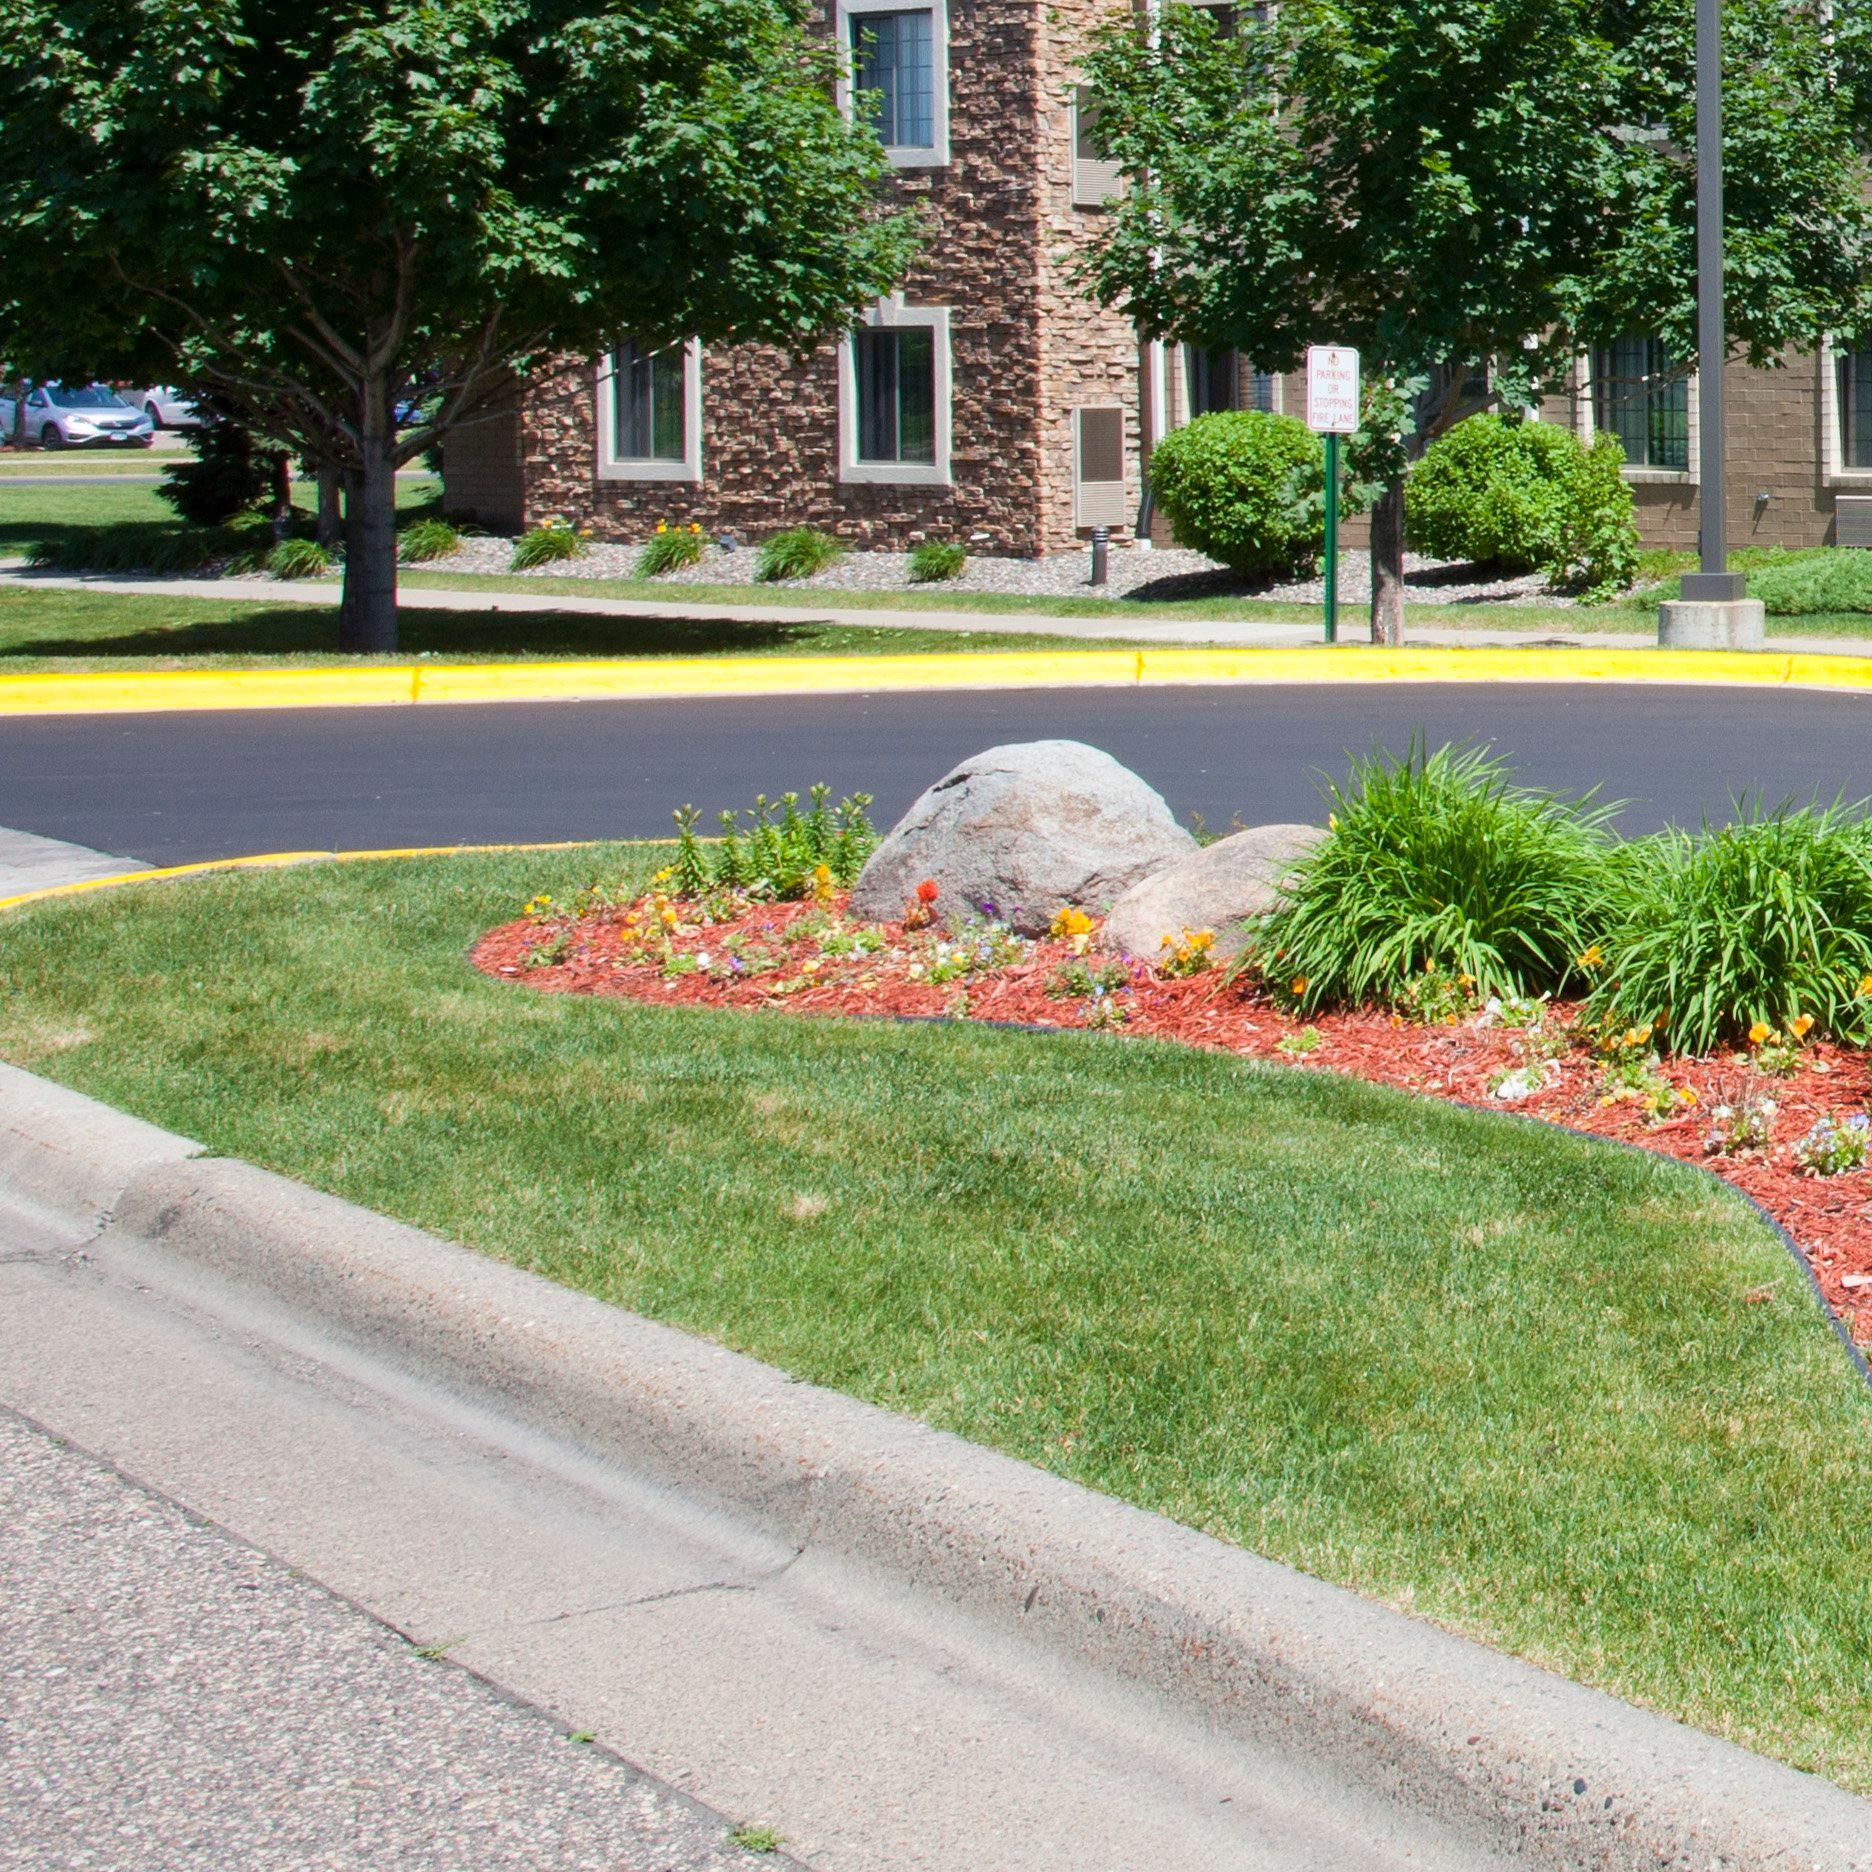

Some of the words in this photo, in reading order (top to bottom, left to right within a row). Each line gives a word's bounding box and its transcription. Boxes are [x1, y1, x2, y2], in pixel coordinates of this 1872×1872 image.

[1316, 370, 1351, 381] PARKING
[1328, 384, 1340, 394] OR
[1314, 397, 1353, 409] STOPPING
[1312, 412, 1329, 424] FIRE
[1332, 412, 1353, 424] LANE
